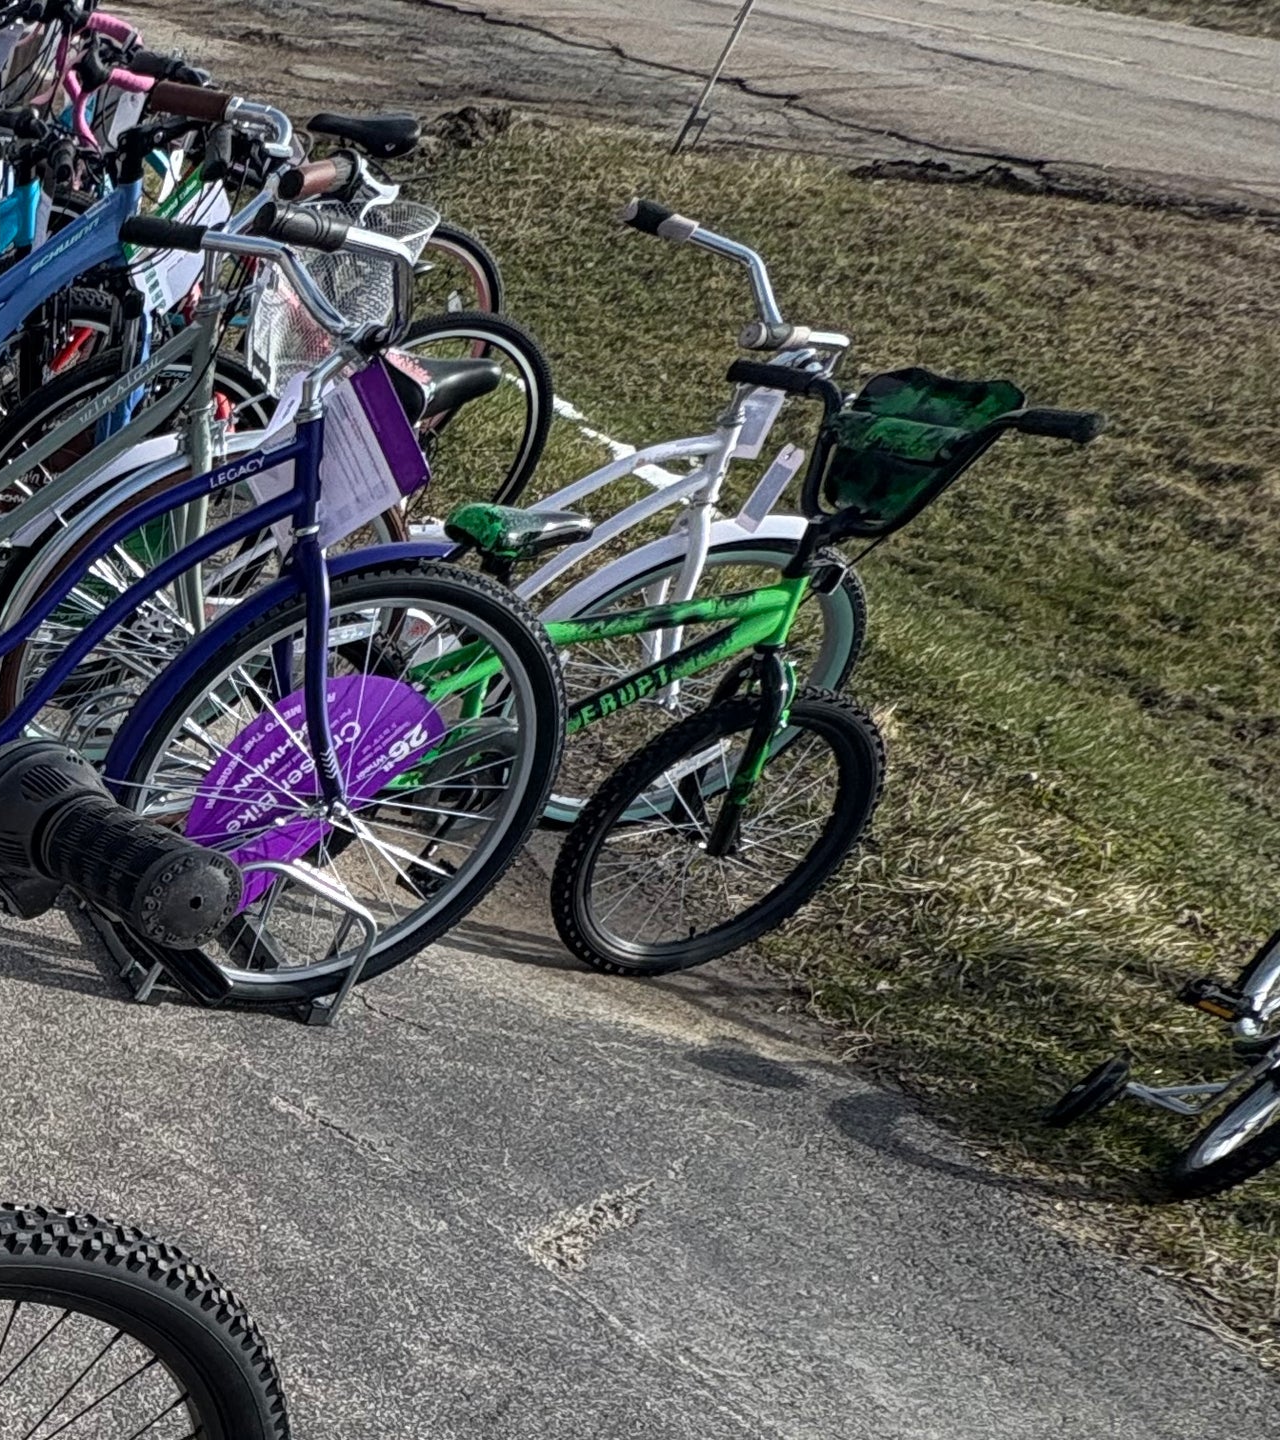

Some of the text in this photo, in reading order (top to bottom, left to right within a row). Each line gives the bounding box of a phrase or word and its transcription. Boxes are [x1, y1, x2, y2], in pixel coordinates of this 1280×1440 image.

[29, 217, 100, 276] SCHWINN
[209, 456, 266, 489] LEGACY
[226, 722, 362, 833] Crser Bike
[232, 721, 308, 794] SCHWINN
[355, 723, 429, 781] 26" Wheel
